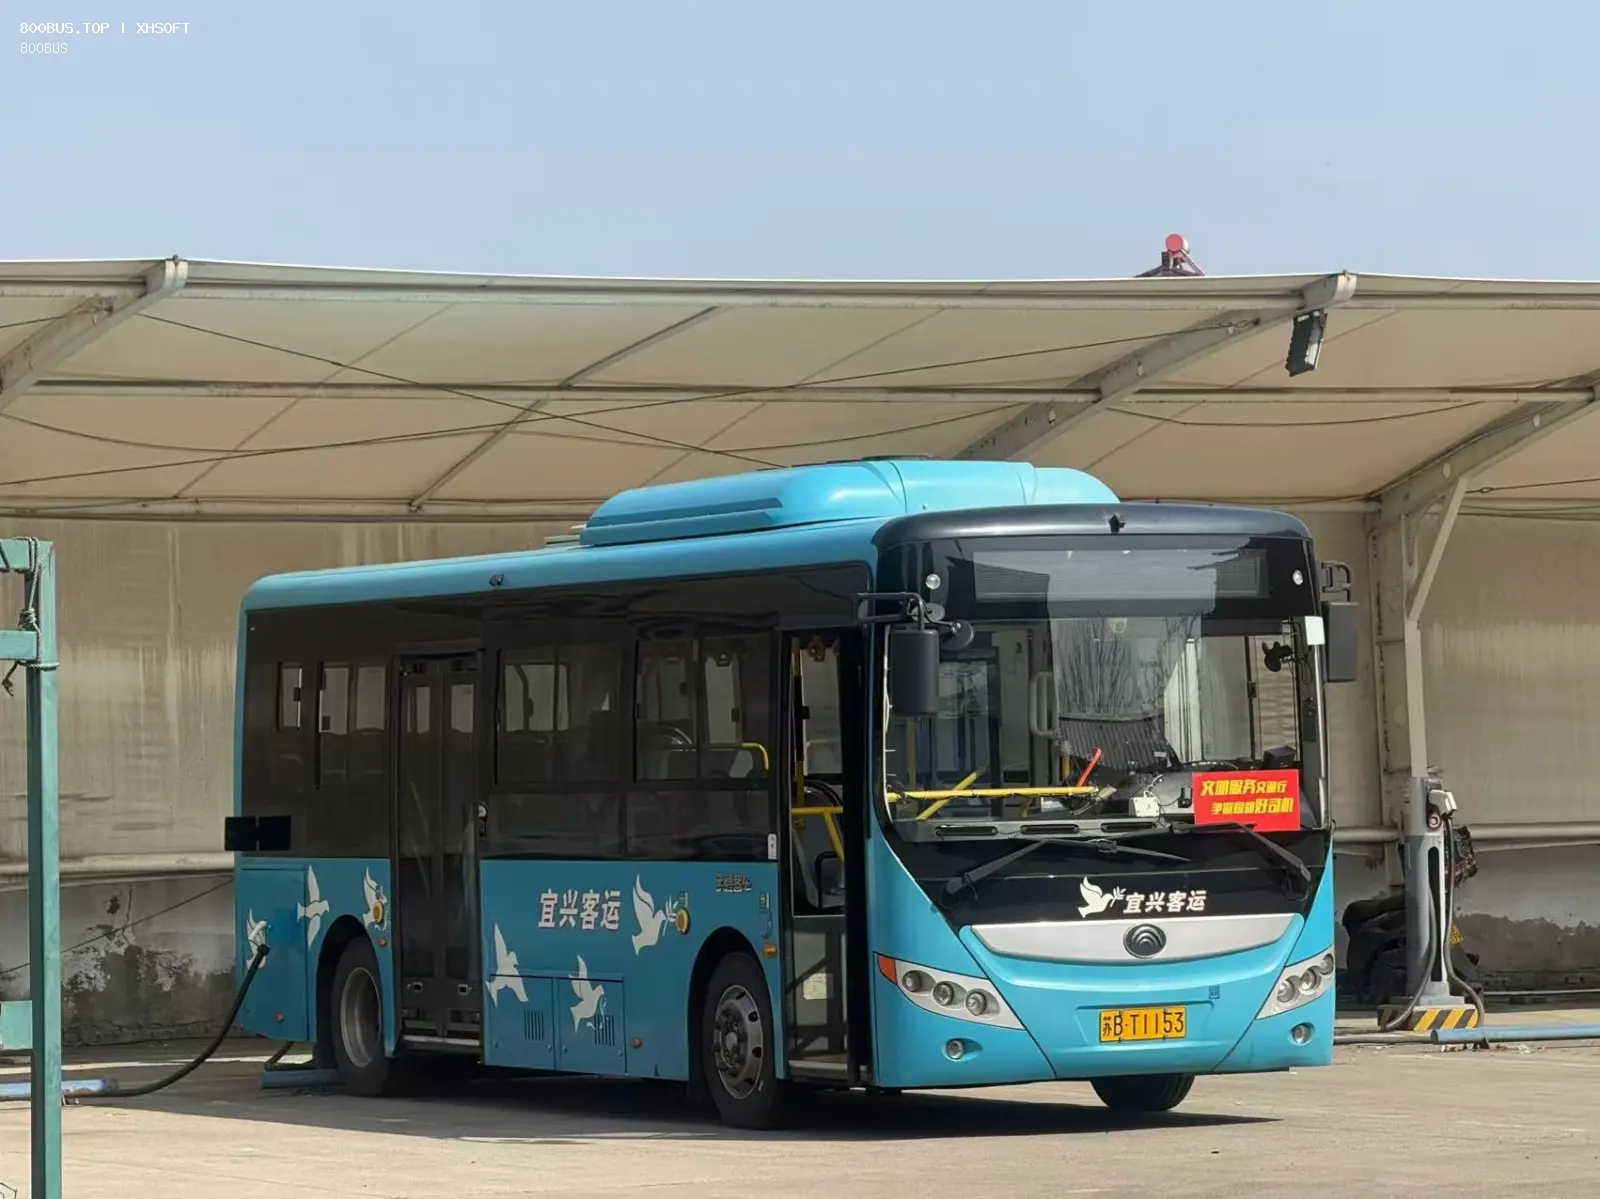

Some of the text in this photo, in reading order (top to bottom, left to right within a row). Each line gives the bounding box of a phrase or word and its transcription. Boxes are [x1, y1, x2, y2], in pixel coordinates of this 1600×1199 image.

[538, 888, 621, 931] 宜兴客运
[1123, 890, 1207, 914] 宜兴客运
